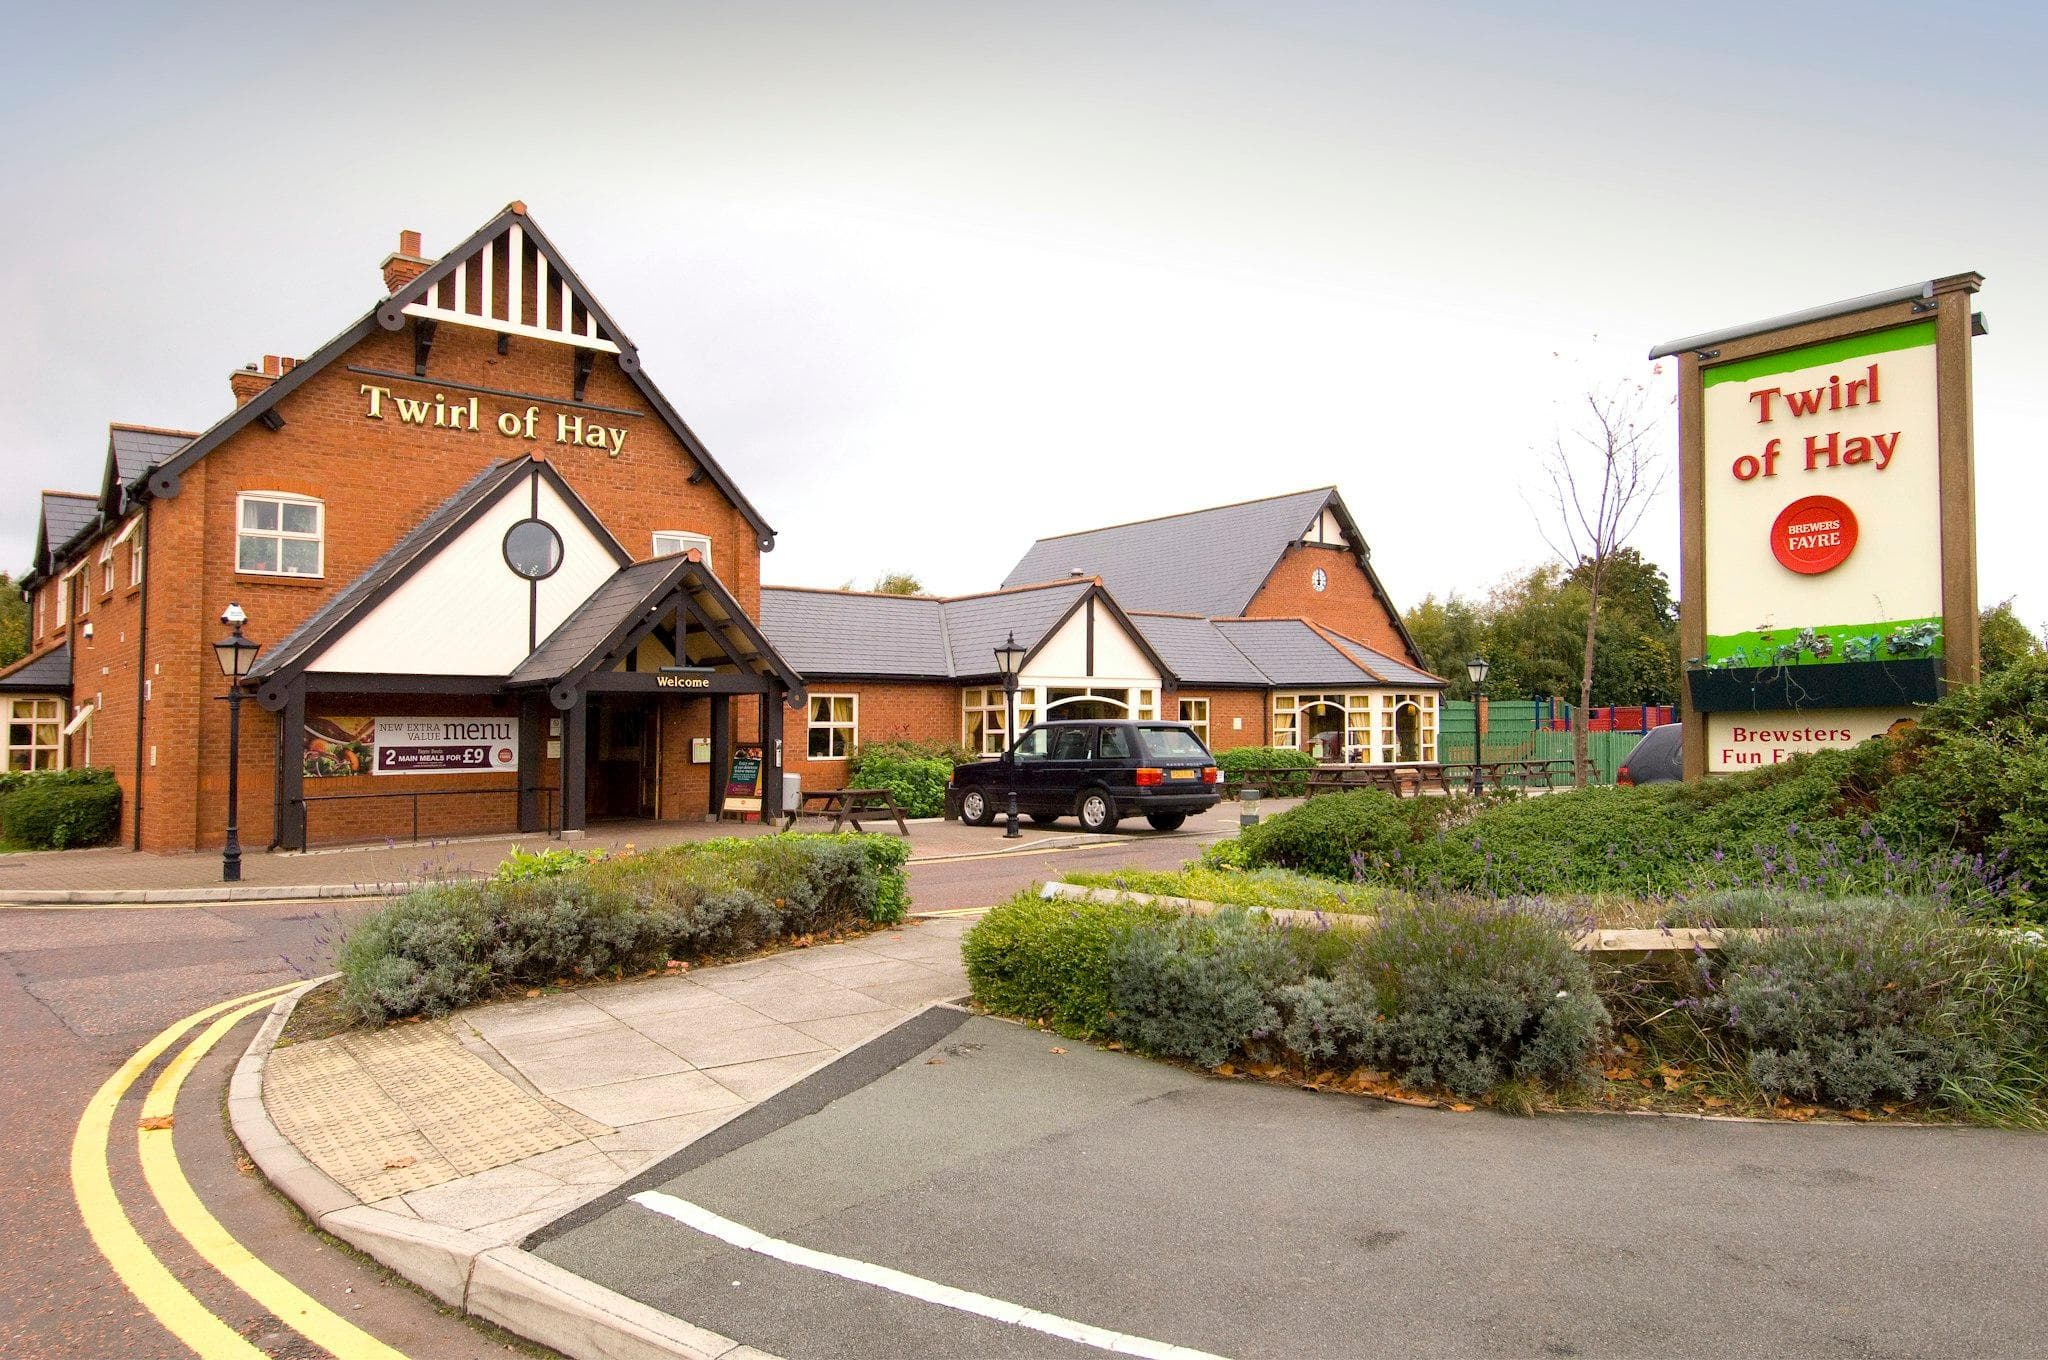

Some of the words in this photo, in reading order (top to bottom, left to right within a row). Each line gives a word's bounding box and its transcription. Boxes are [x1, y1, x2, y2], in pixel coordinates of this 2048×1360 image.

[1749, 363, 1881, 424] Twirl
[360, 384, 479, 432] Twirl
[497, 406, 539, 440] of
[556, 412, 628, 458] Hay
[1732, 438, 1781, 481] of
[1803, 431, 1901, 471] Hay
[1788, 520, 1840, 535] BREWERS
[1789, 532, 1841, 551] FAYRE
[656, 676, 710, 688] Welcome
[379, 723, 403, 732] NEW
[406, 723, 441, 732] EXTRA
[443, 723, 512, 740] menu
[1733, 727, 1851, 742] Brewsters
[407, 732, 441, 741] VALUE
[385, 749, 397, 765] 2
[398, 754, 418, 762] MAIN
[420, 754, 445, 762] MEALS
[463, 748, 484, 764] £9
[1722, 749, 1762, 764] Fun
